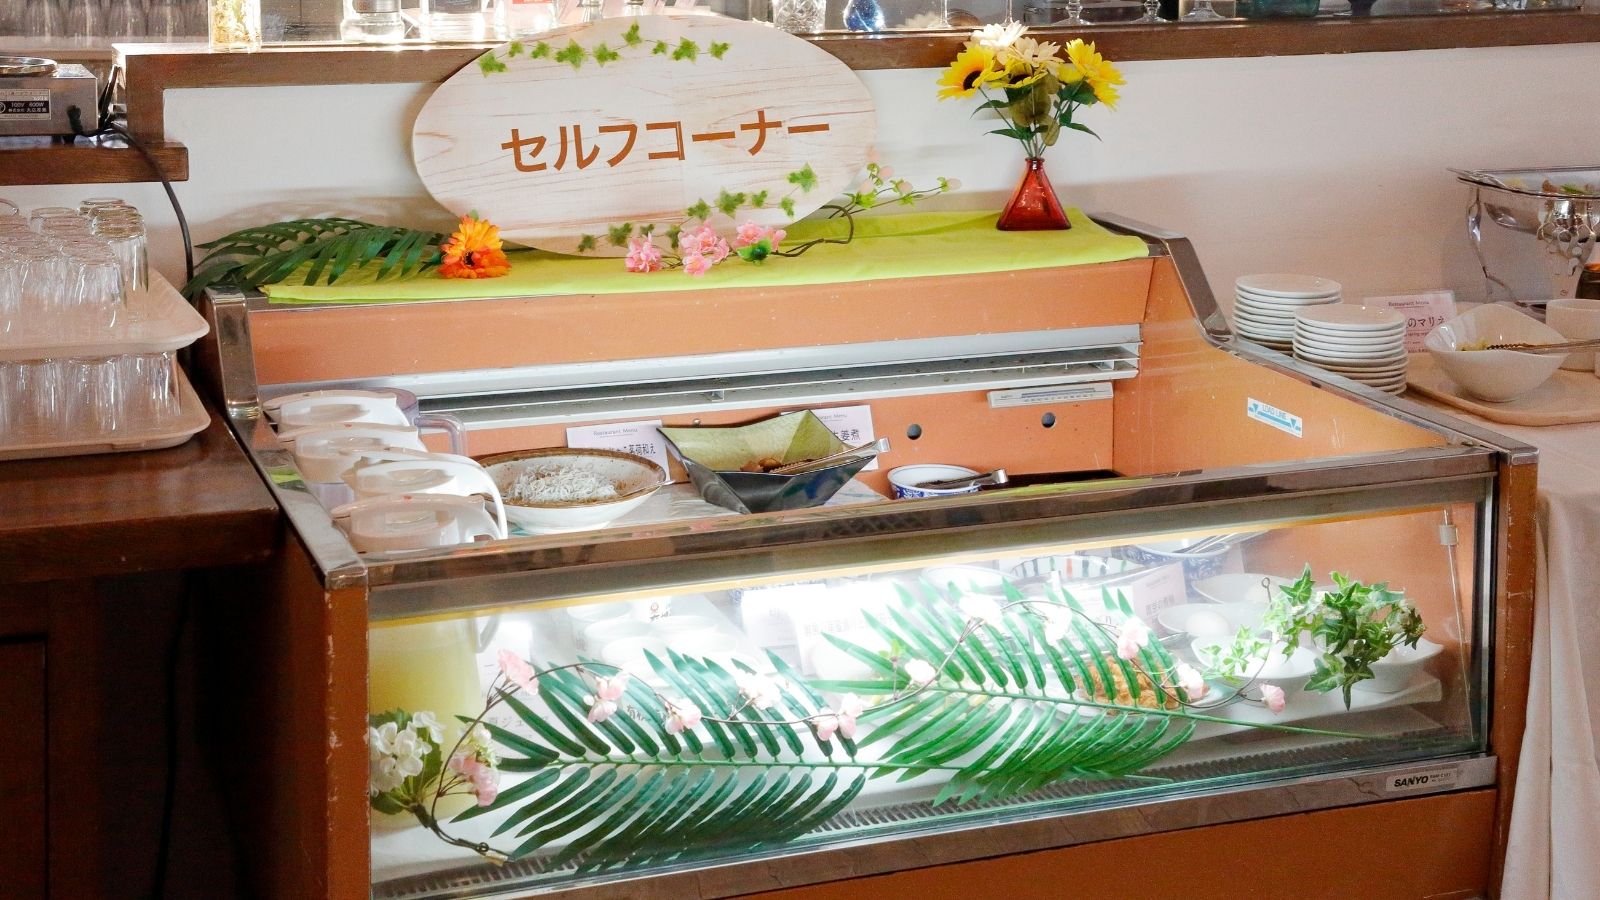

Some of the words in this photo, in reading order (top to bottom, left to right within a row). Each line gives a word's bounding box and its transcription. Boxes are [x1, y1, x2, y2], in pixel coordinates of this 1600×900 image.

[501, 109, 830, 173] セルフコーナー
[1394, 775, 1429, 788] SANYO
